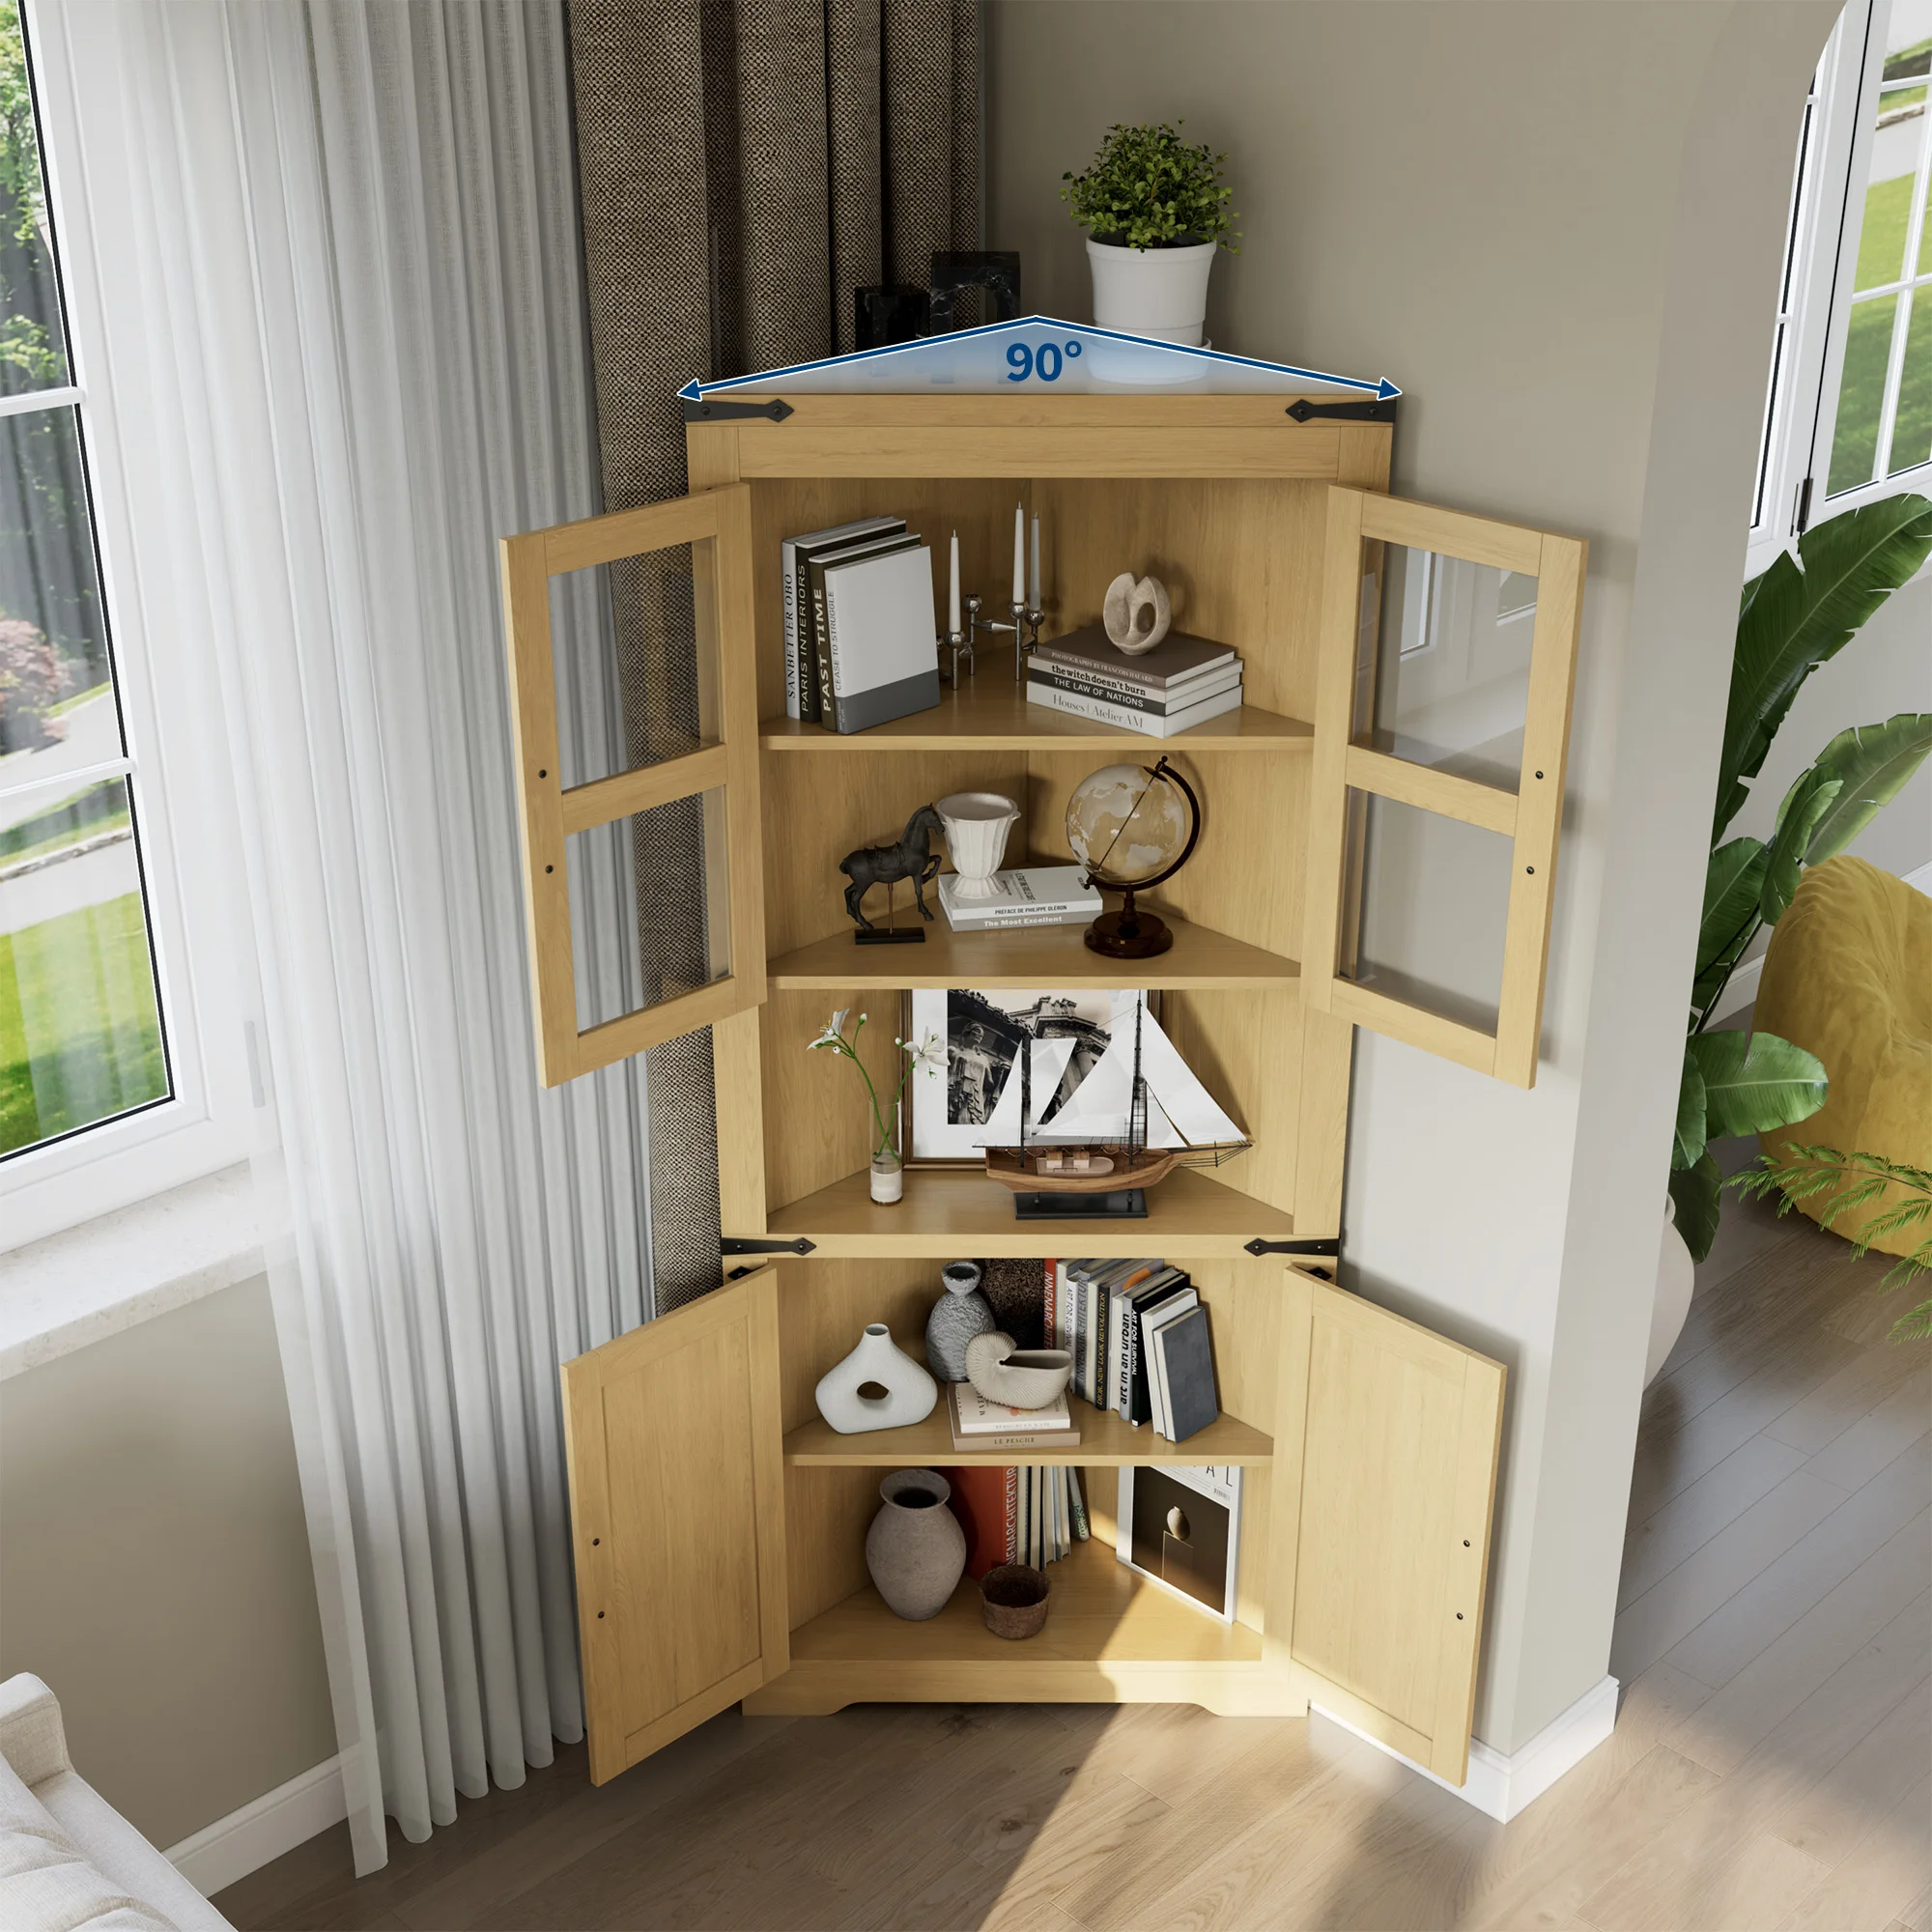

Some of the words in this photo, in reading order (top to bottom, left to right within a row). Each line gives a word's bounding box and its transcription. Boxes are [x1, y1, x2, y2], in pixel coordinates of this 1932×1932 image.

[784, 574, 793, 606] OBO
[797, 564, 807, 658] INTERIORS
[813, 588, 826, 645] TIME
[828, 591, 838, 641] STRUGGLE
[784, 611, 795, 698] SANBETTER
[832, 644, 838, 656] TO
[799, 662, 809, 712] PARIS
[819, 655, 831, 712] PAST
[833, 659, 841, 691] CEASE
[1051, 665, 1065, 674] the
[1065, 668, 1091, 682] witch
[1091, 674, 1123, 691] doesn't
[1124, 683, 1147, 696] burn
[1054, 676, 1070, 688] THE
[1073, 682, 1091, 694] LAW
[1093, 688, 1104, 696] OF
[1106, 691, 1144, 708] NATIONS
[1053, 694, 1085, 712] Houses
[1092, 705, 1123, 723] Atelier
[1024, 916, 1063, 924] Excellent
[1043, 1270, 1053, 1350] INNENARCHITE
[1122, 1313, 1130, 1350] urban
[1121, 1353, 1129, 1369] an
[1121, 1371, 1128, 1384] in
